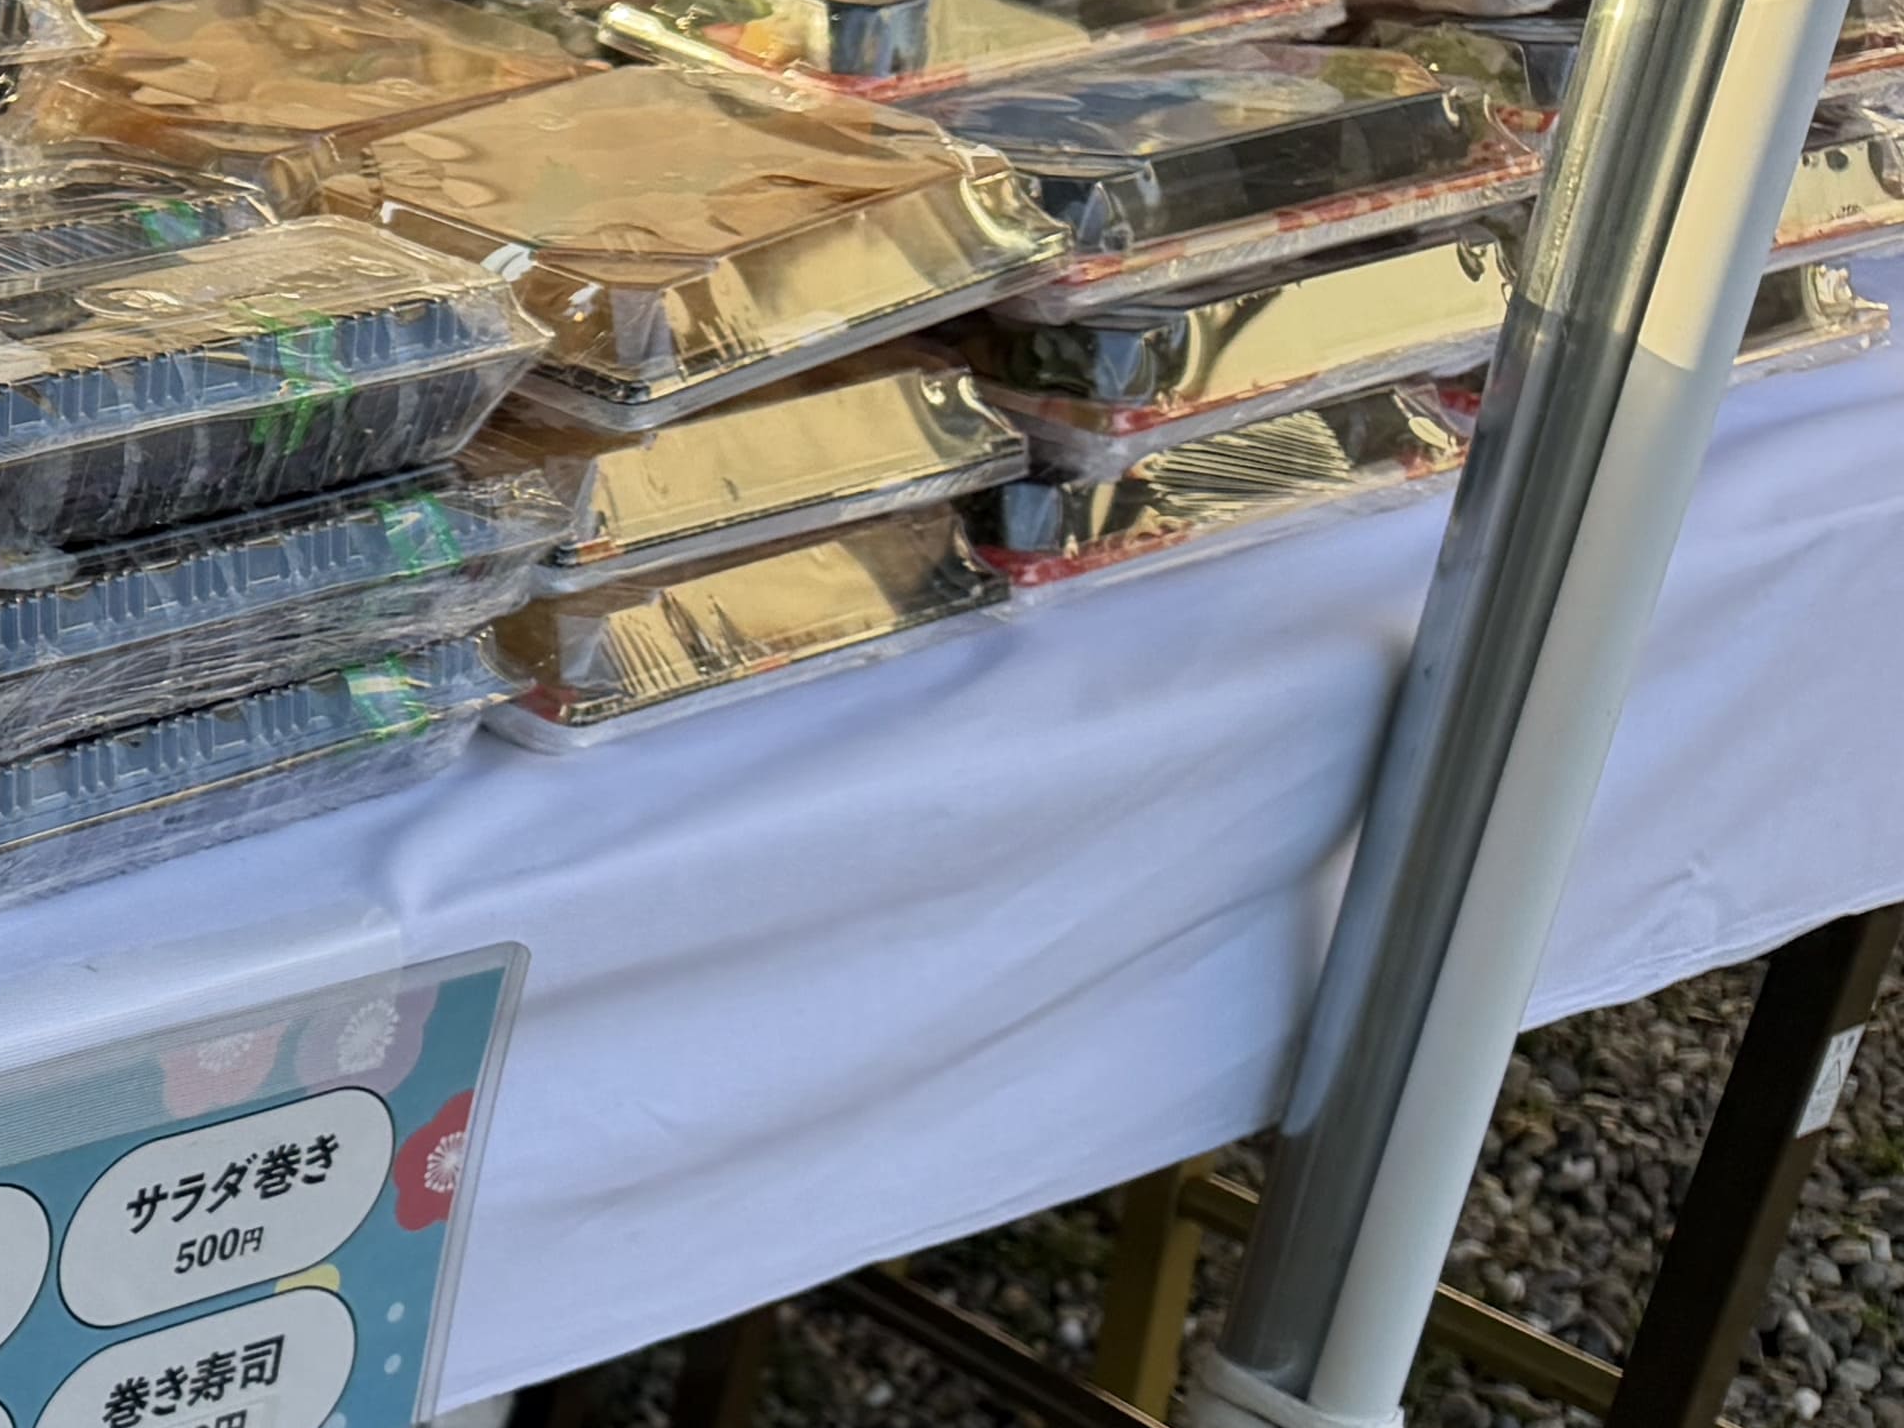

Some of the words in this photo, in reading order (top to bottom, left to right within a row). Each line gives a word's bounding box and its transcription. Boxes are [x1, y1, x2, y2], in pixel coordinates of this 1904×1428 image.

[126, 1134, 340, 1235] サラダ巻き
[174, 1226, 265, 1275] 500円
